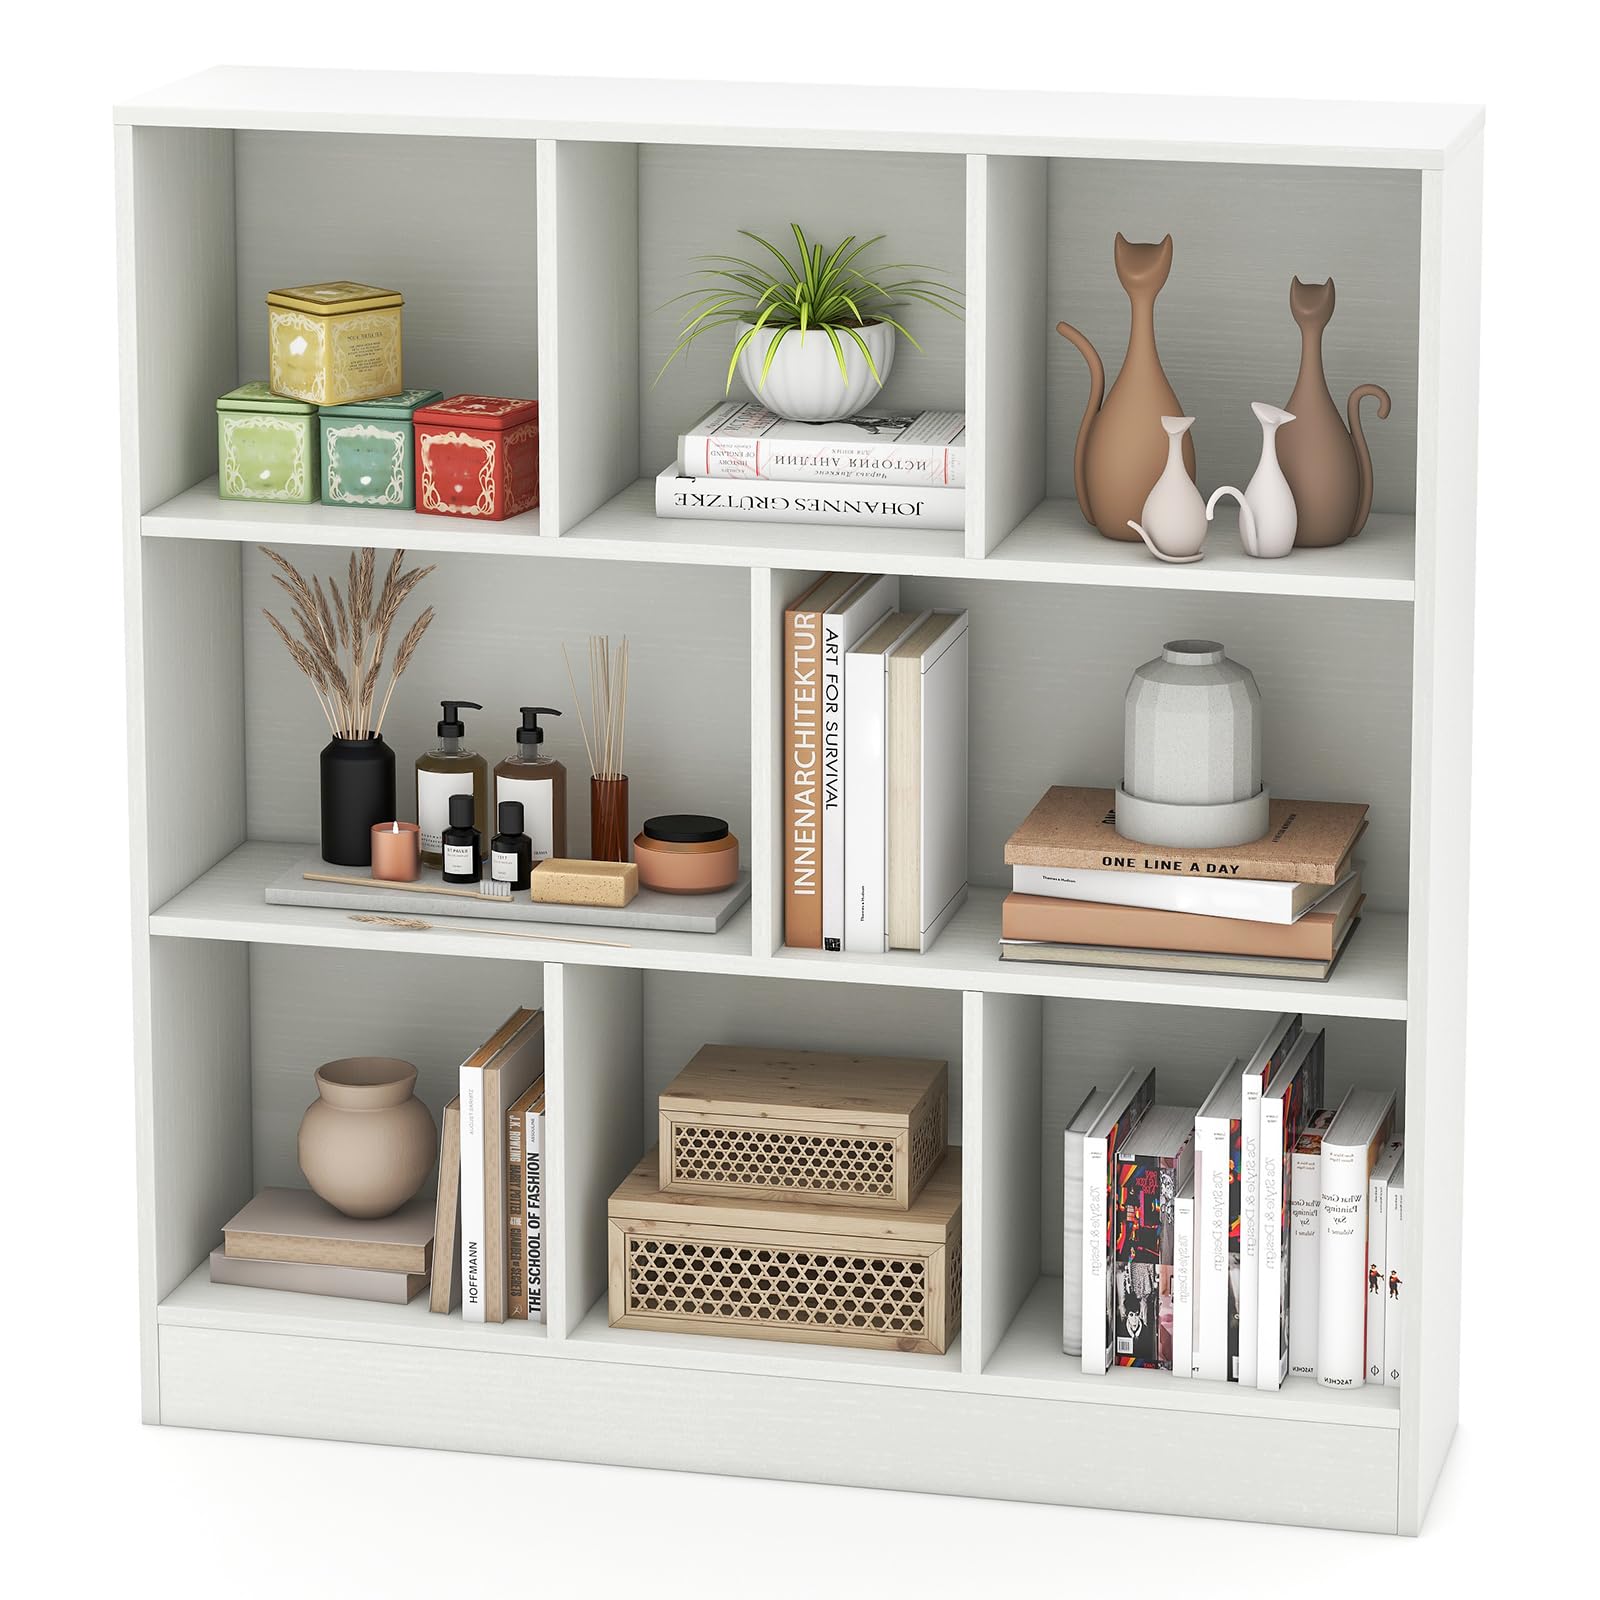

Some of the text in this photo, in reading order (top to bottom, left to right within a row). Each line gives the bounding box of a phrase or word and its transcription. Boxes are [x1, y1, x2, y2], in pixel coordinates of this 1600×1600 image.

[718, 459, 748, 467] HISTORY
[775, 455, 926, 470] ИСТОРИЯ АНГЛИИ
[815, 469, 887, 479] Чарльз Диккенс
[674, 492, 924, 516] JOHANNES GRÜTZKE
[825, 628, 839, 810] ART FOR SURVIVAL
[794, 612, 817, 896] INNENARCHITEKTUR
[1102, 856, 1240, 875] ONE LINE A DAY
[508, 1115, 520, 1129] J.K.
[509, 1130, 521, 1162] ROWLING
[509, 1164, 521, 1187] HARRY
[509, 1189, 521, 1215] POTTER
[510, 1228, 521, 1261] CHAMBER
[527, 1152, 540, 1313] THE SCHOOL OF FASHION
[468, 1241, 478, 1304] HOFFMANN
[510, 1267, 521, 1296] SECRETS
